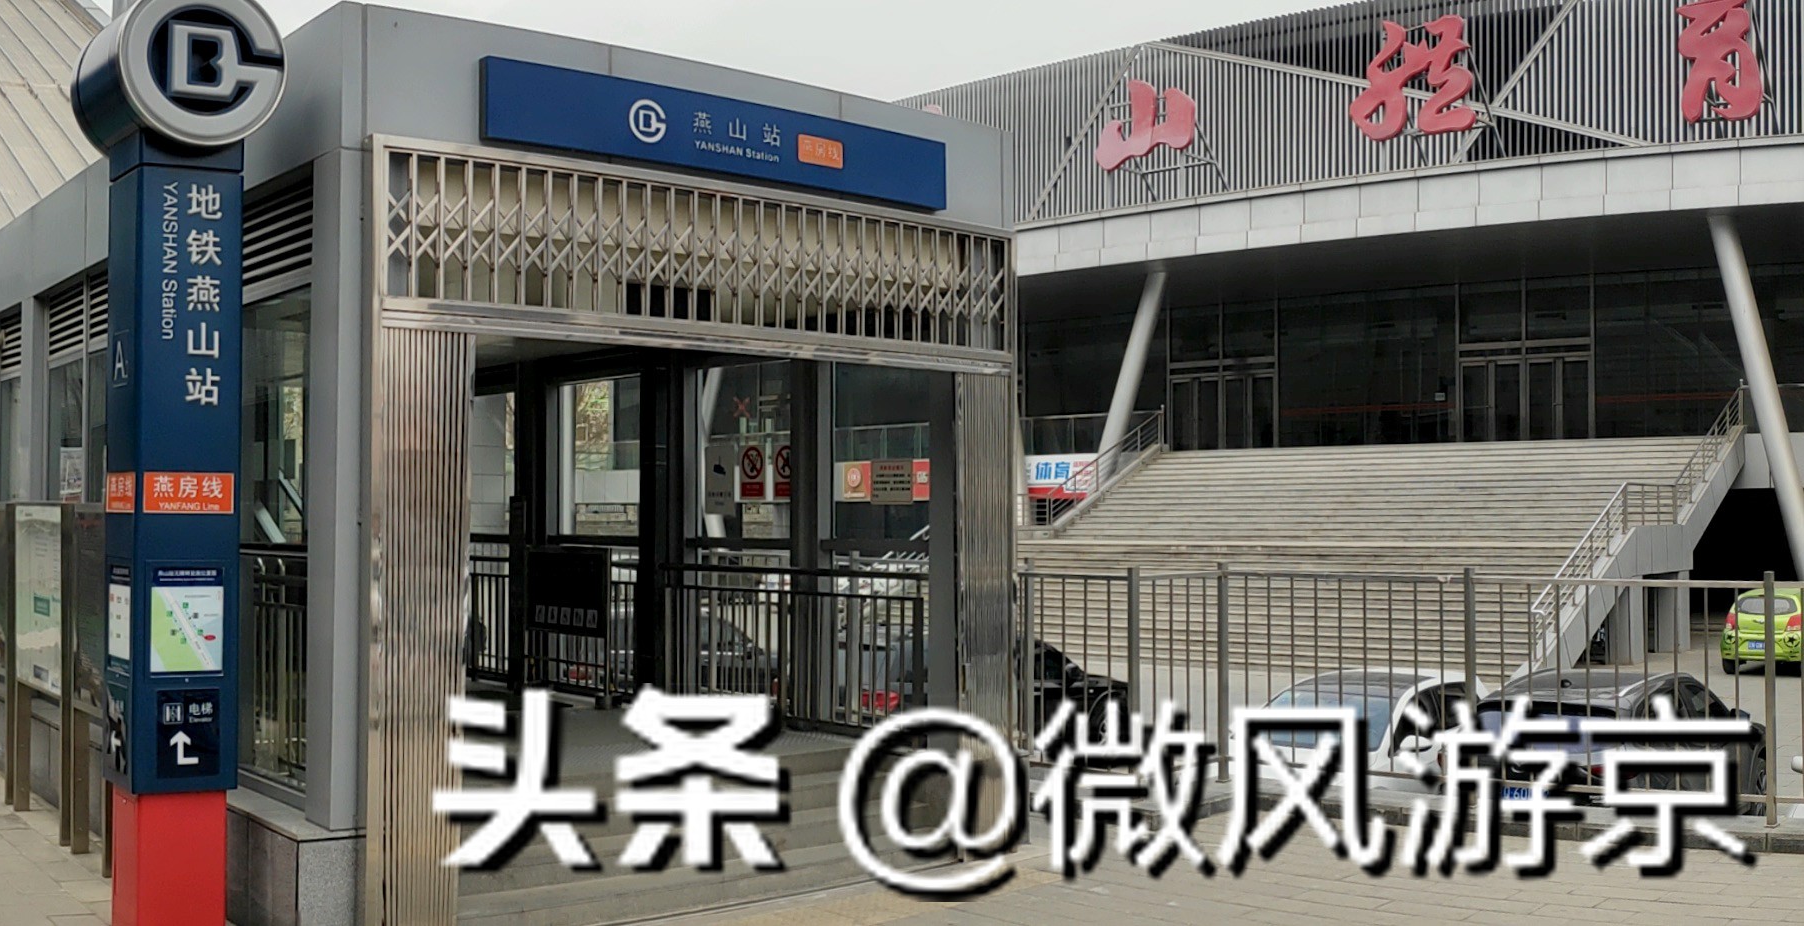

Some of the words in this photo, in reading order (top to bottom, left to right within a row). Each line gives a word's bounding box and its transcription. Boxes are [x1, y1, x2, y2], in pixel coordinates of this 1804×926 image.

[693, 111, 781, 148] 燕山站
[694, 140, 743, 157] YANSHAN
[745, 148, 779, 163] Station
[162, 181, 179, 274] YANSHAN
[185, 184, 223, 406] 地铁燕山站
[162, 279, 179, 341] Station
[1035, 461, 1070, 480] 体育
[153, 475, 223, 499] 燕房线
[158, 502, 201, 511] YANFANG
[189, 701, 214, 716] 电梯
